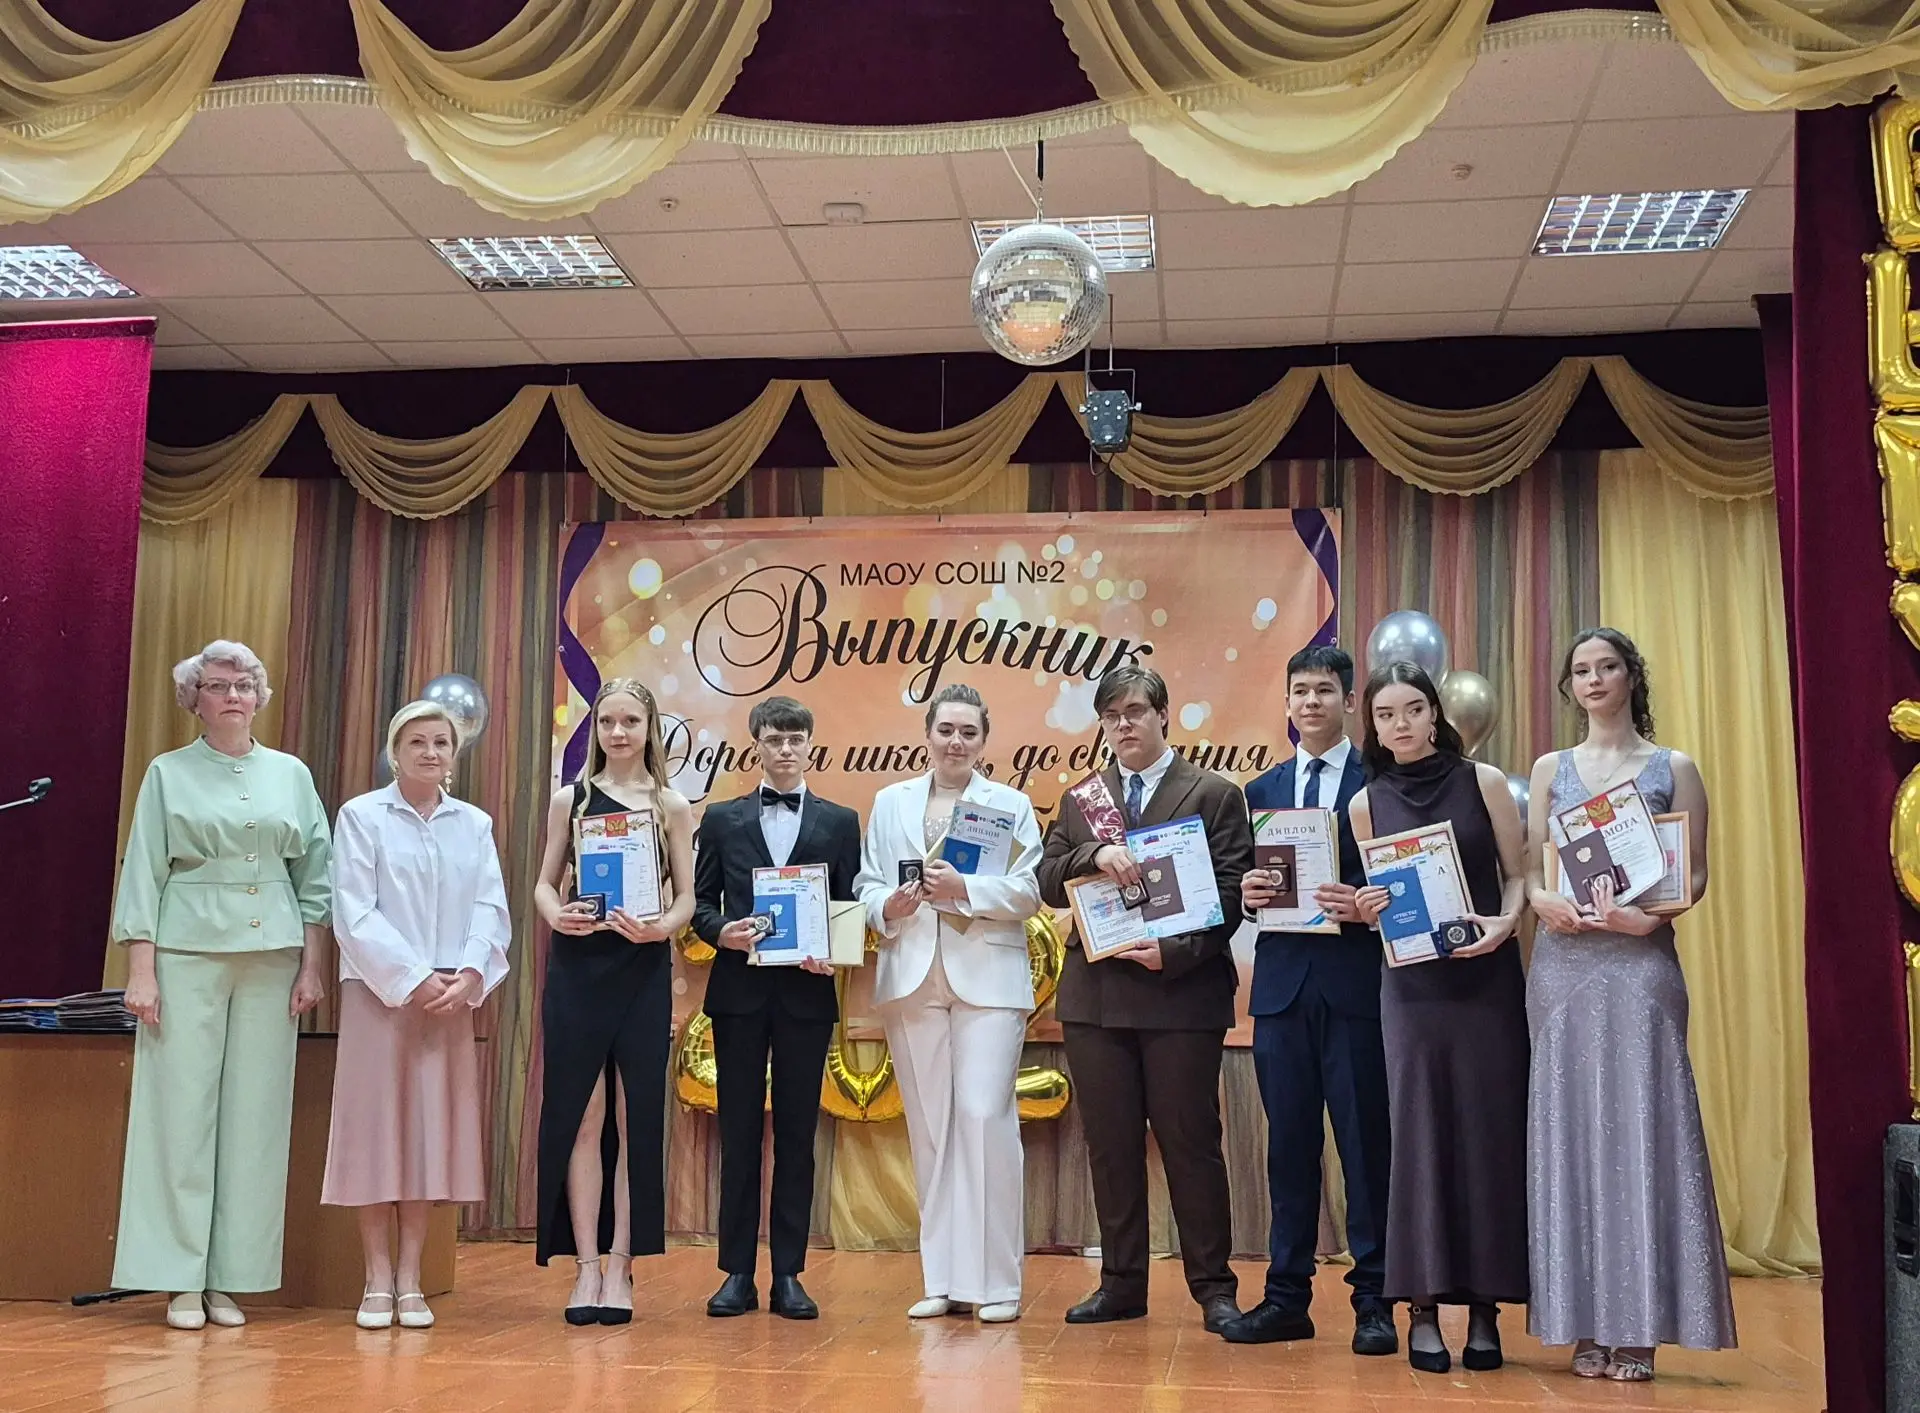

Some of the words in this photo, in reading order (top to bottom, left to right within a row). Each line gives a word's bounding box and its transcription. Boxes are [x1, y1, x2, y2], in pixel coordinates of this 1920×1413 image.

[840, 562, 925, 586] МАОУ
[934, 561, 1006, 585] СОШ
[1017, 560, 1065, 584] №2
[693, 563, 1154, 703] Выпускник
[1007, 744, 1061, 791] до
[1267, 825, 1317, 837] ДИПЛОМ
[1604, 816, 1639, 838] МОТА
